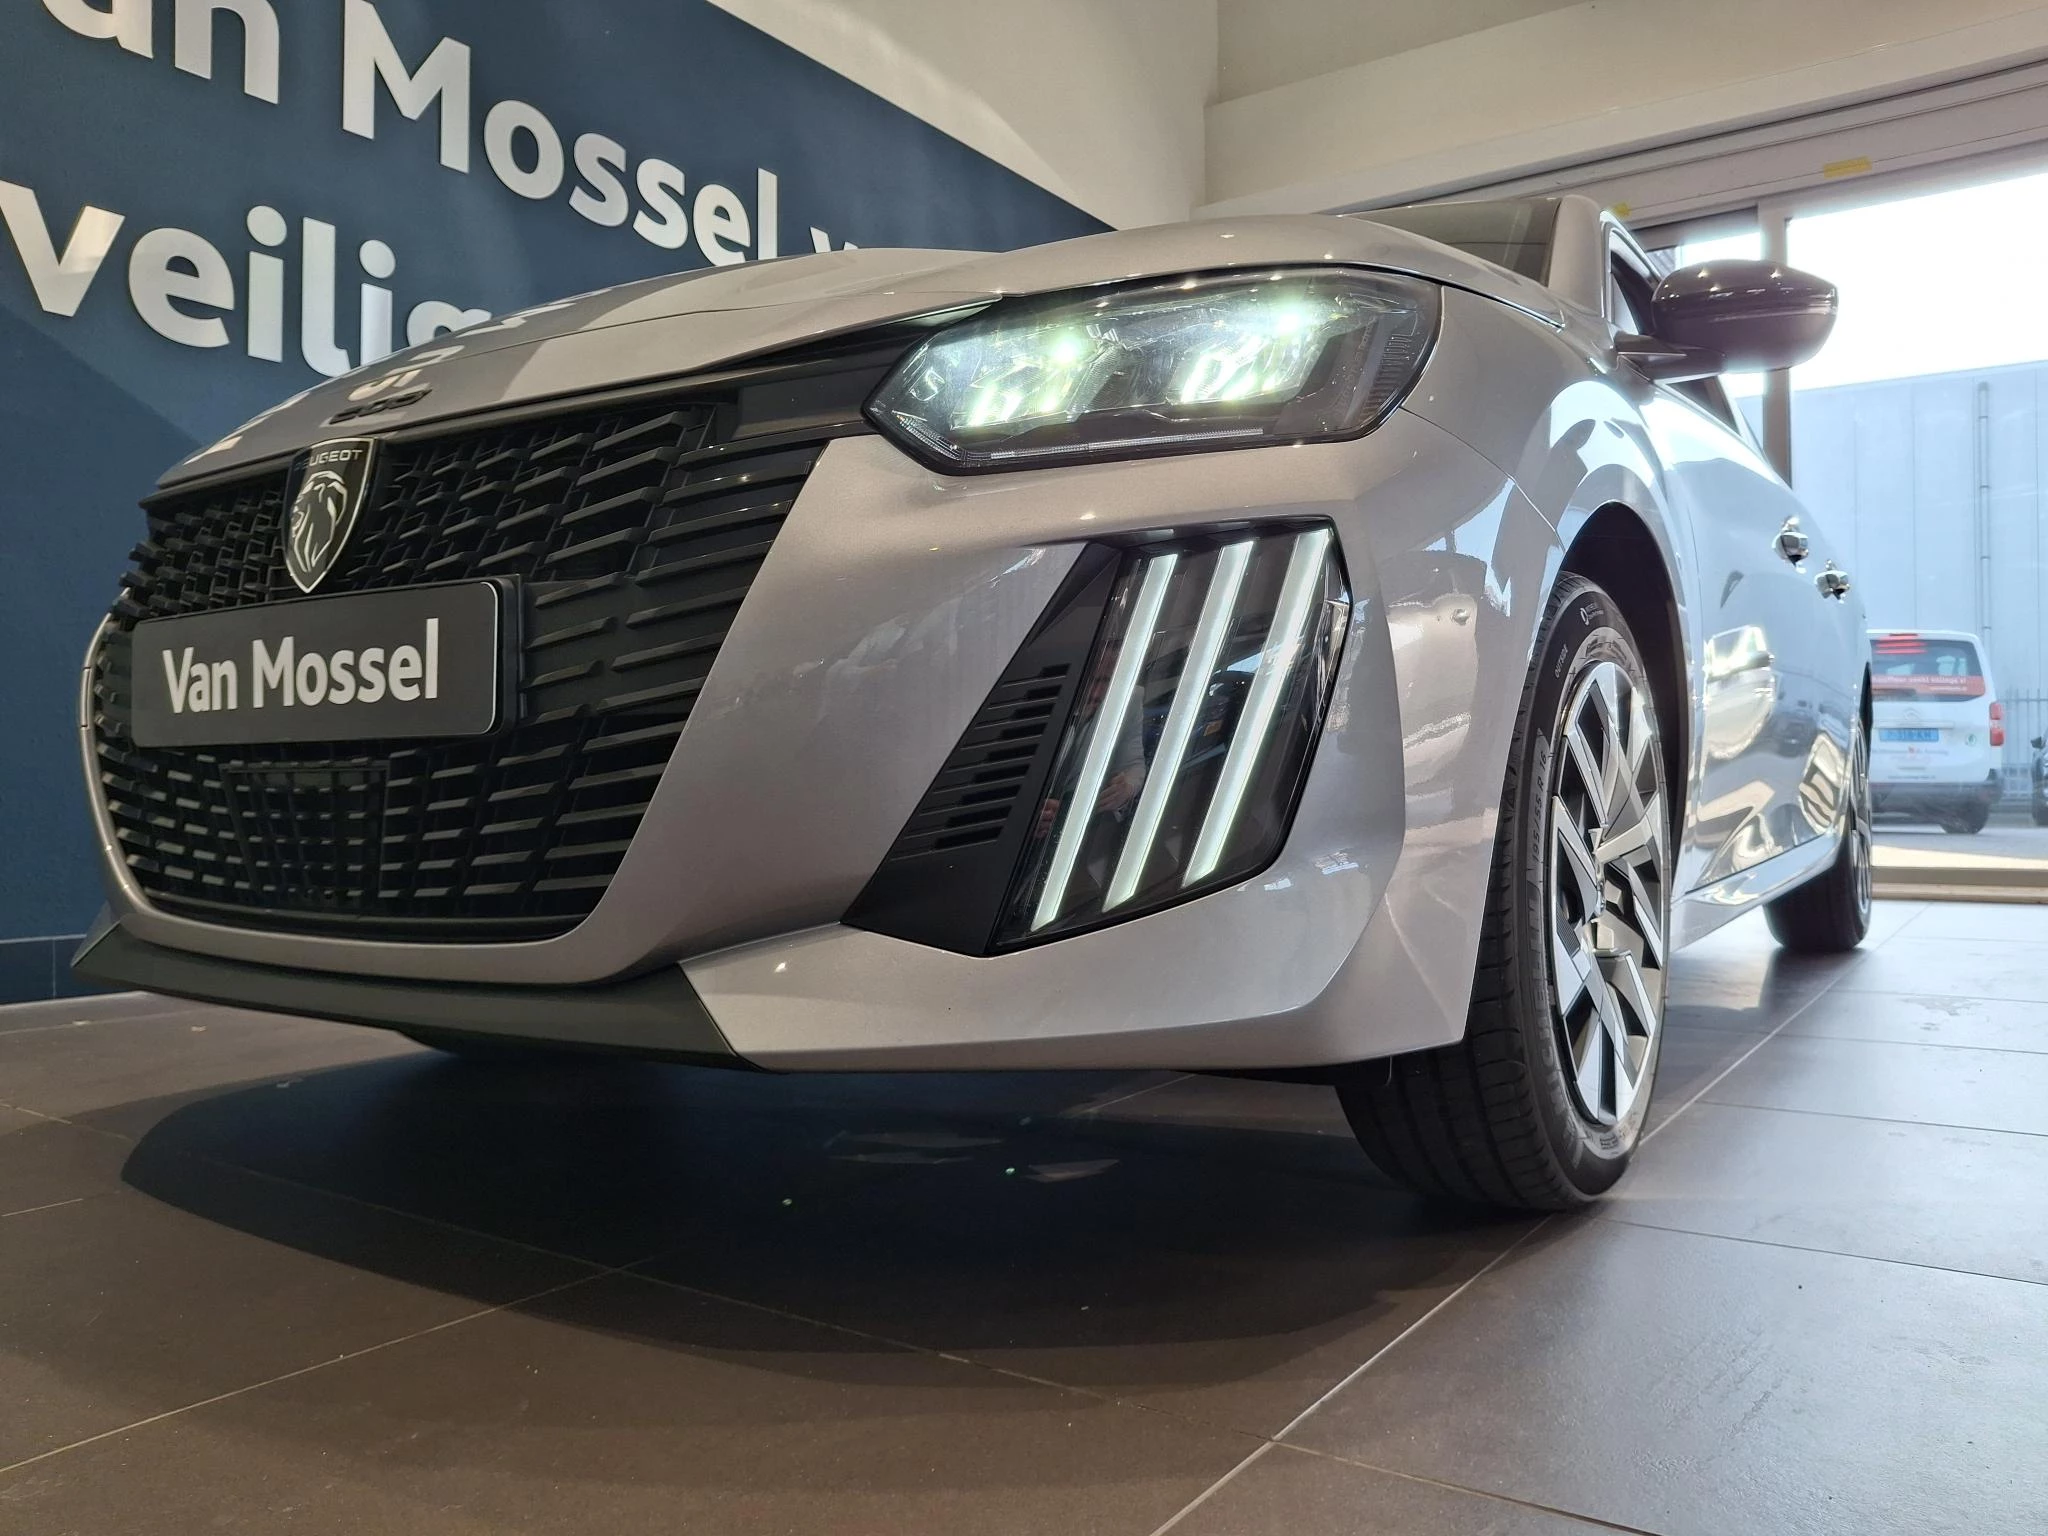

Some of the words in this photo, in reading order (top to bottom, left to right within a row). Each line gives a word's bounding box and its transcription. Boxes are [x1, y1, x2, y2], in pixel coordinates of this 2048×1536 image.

[342, 0, 778, 266] Mossel
[162, 646, 238, 714] Van
[252, 617, 439, 708] Mossel
